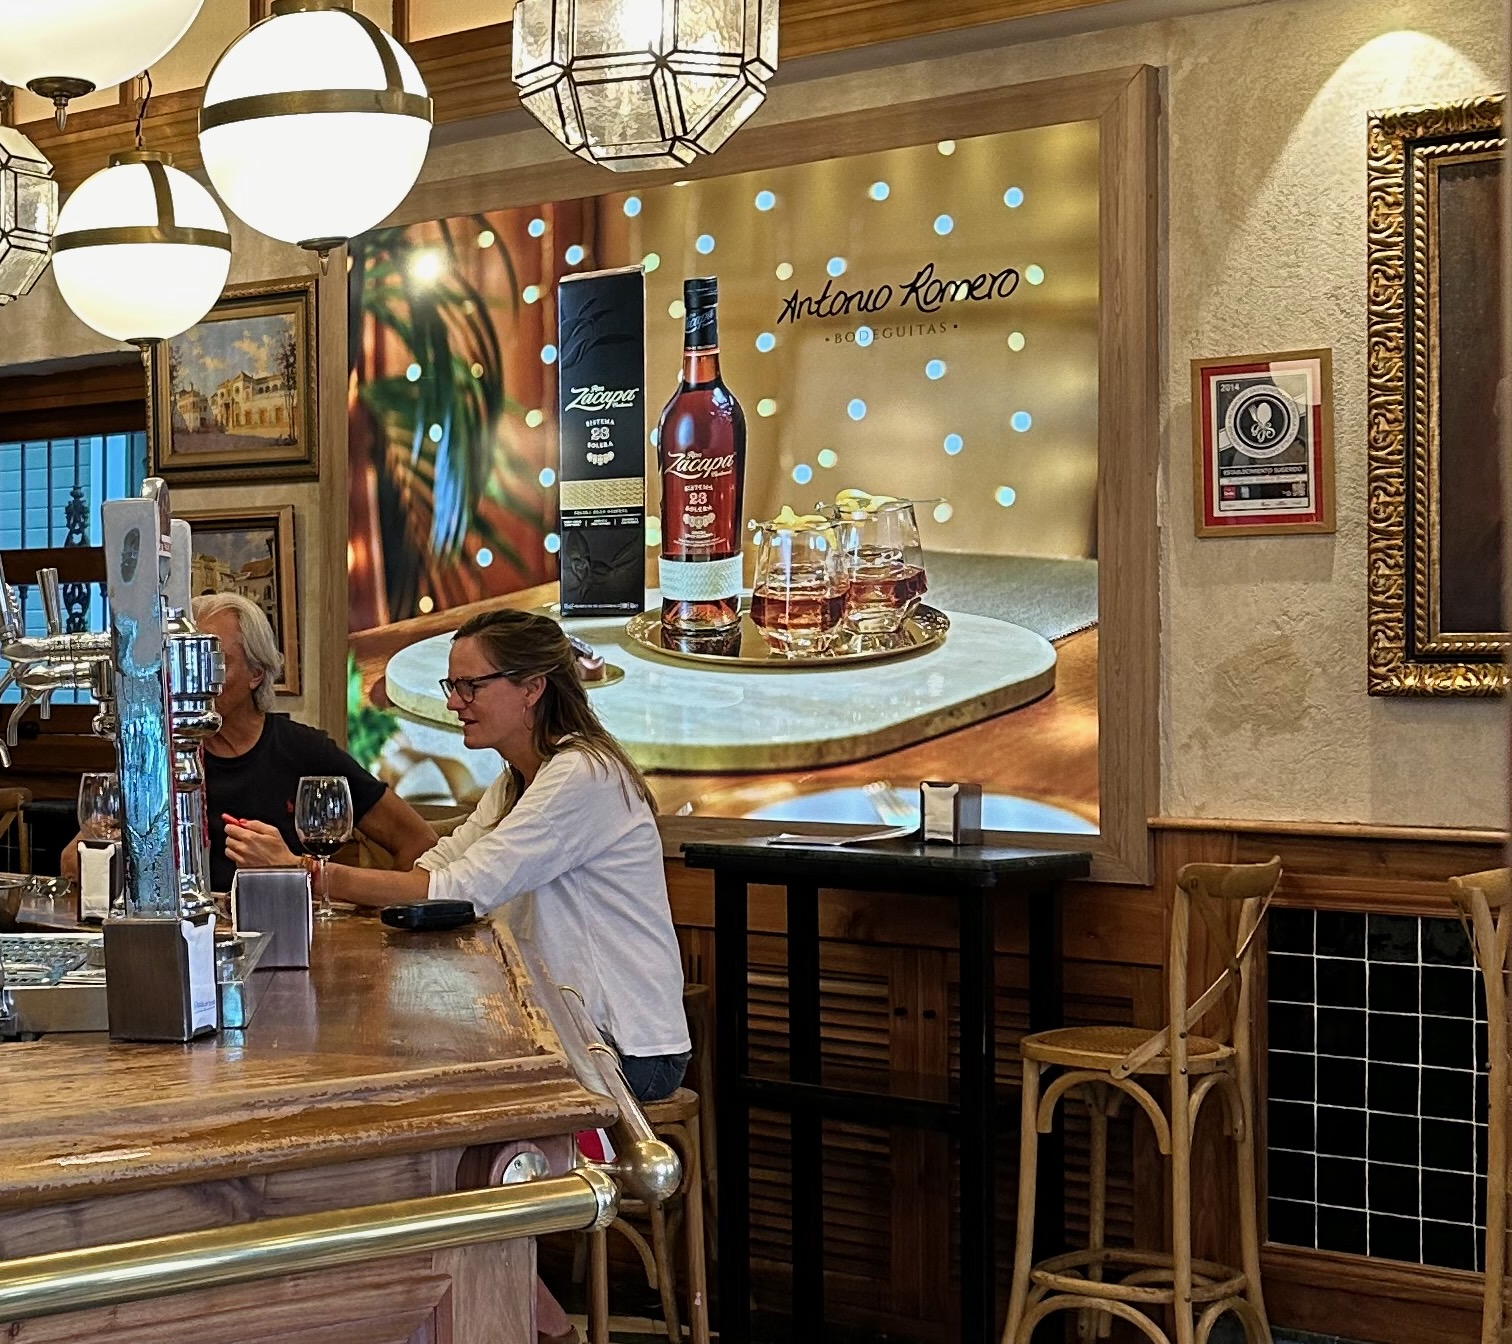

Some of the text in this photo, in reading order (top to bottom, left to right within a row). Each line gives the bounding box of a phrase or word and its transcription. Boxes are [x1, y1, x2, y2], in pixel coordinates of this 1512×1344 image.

[776, 262, 1020, 325] Antonio Romero
[565, 387, 640, 412] Zacapa
[1220, 383, 1240, 393] 2014
[664, 451, 736, 480] Zacapa
[689, 493, 707, 505] 23
